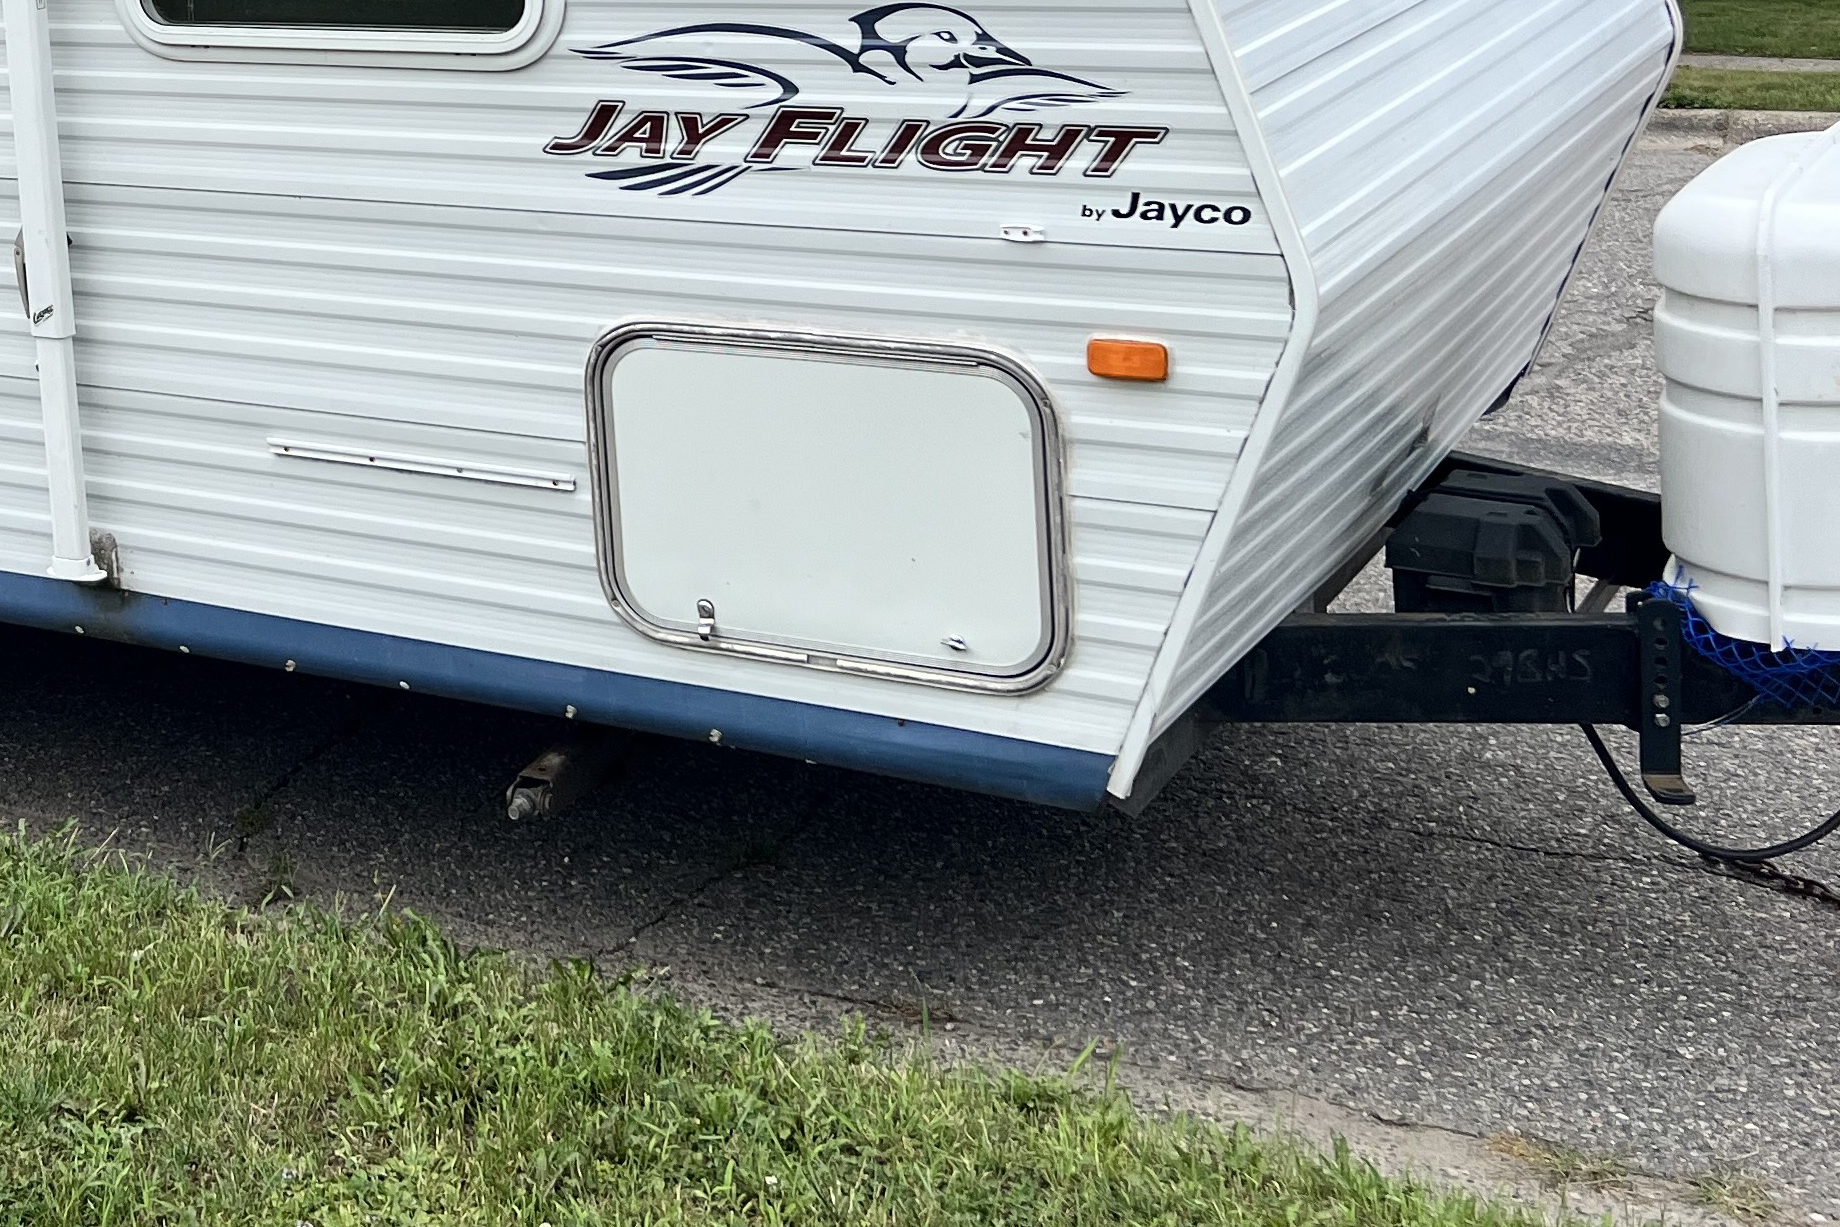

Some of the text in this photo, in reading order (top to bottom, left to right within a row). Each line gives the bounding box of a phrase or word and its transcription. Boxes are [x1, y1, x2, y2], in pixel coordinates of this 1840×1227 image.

[543, 99, 1169, 179] JAY FLIGHT
[1081, 190, 1253, 228] by Jayco
